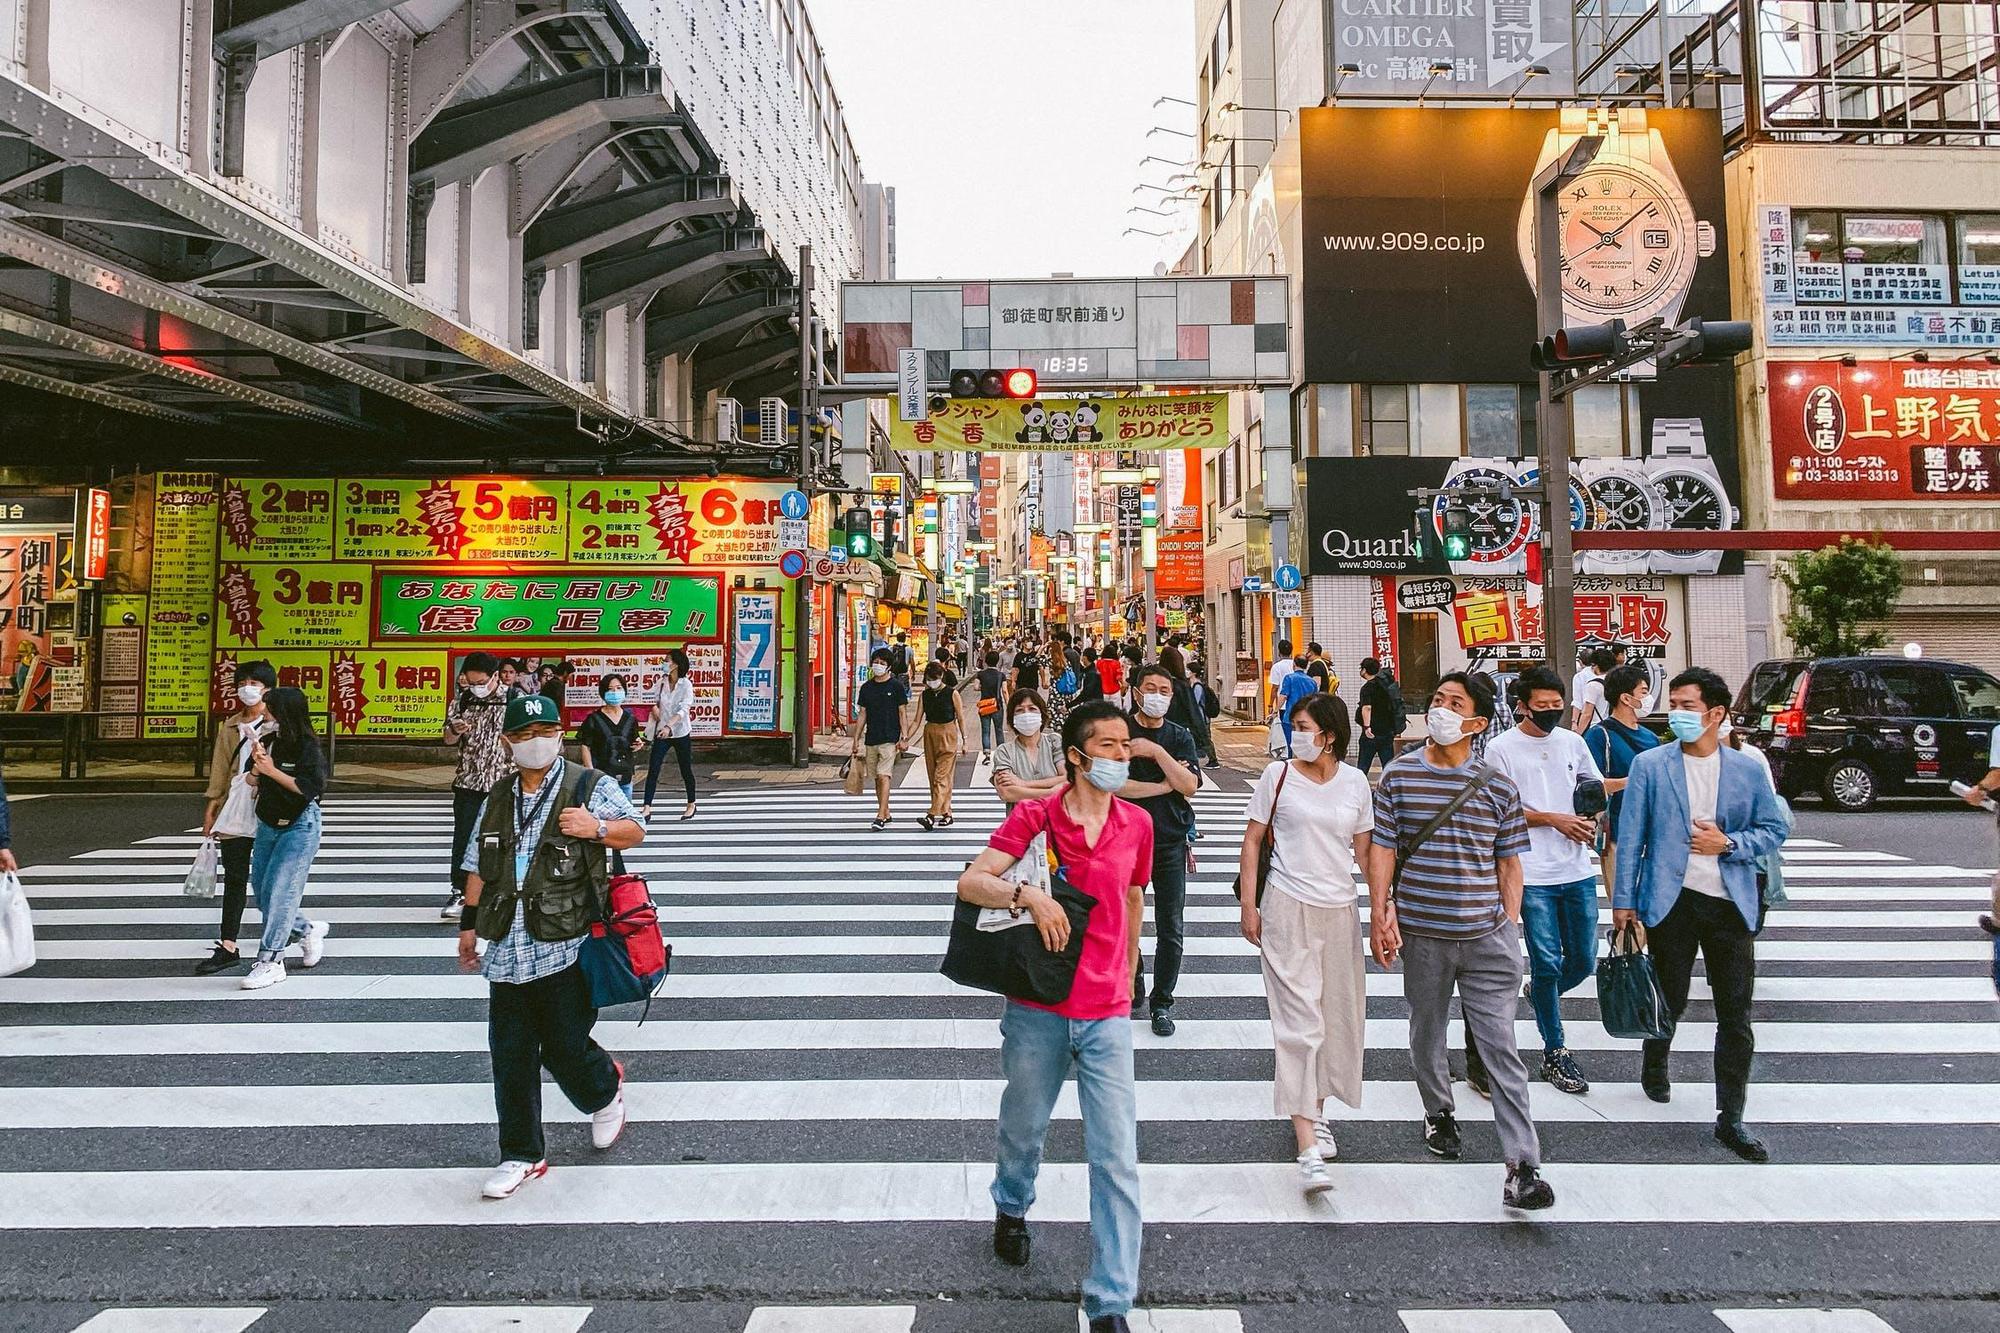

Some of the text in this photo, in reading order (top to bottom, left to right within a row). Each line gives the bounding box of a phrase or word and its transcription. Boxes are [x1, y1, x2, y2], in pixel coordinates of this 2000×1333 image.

[1342, 0, 1475, 17] CARTIER
[1342, 25, 1454, 48] OMEGA
[1324, 232, 1485, 252] www.909.co.jp
[1646, 234, 1666, 244] 15
[1964, 269, 1981, 278] Let
[1965, 293, 1981, 301] the
[1002, 307, 1125, 323] 御徒町駅前通り
[1043, 357, 1087, 373] 18:35
[907, 351, 919, 418] スクランブル交差点
[1903, 370, 2000, 389] 本格台湾式
[1118, 402, 1214, 417] みんなに笑顔を
[1849, 394, 2000, 441] 上野気
[1119, 418, 1214, 439] ありがとう
[1813, 390, 1837, 450] 2号店
[1806, 456, 1842, 468] 11:00
[1806, 469, 1898, 482] 03-3831-3313
[1926, 470, 1989, 492] 足ツボ
[261, 482, 330, 513] 2億円
[345, 482, 400, 505] 3億円
[1121, 486, 1139, 497] 2F
[473, 483, 558, 521] 5億円
[577, 490, 640, 514] 4億円
[470, 524, 562, 534] この売り場から出ました!
[582, 525, 640, 549] 2億円
[1158, 542, 1182, 551] LONDON
[1322, 529, 1417, 558] Quark
[836, 562, 862, 575] 宝くじ
[1339, 560, 1407, 570] www.909.co.jp
[17, 540, 51, 636] 御徒町
[273, 568, 363, 604] 3億円
[398, 579, 670, 602] あなたに届け!!
[1402, 580, 1450, 595] 最短5分の
[741, 597, 770, 607] サマー
[1404, 592, 1451, 608] 無料査定!
[418, 605, 706, 633] 億の正夢!!
[738, 608, 772, 619] ジャンボ
[739, 623, 772, 668] 7
[374, 658, 441, 690] 1億円
[738, 669, 771, 688] 億円
